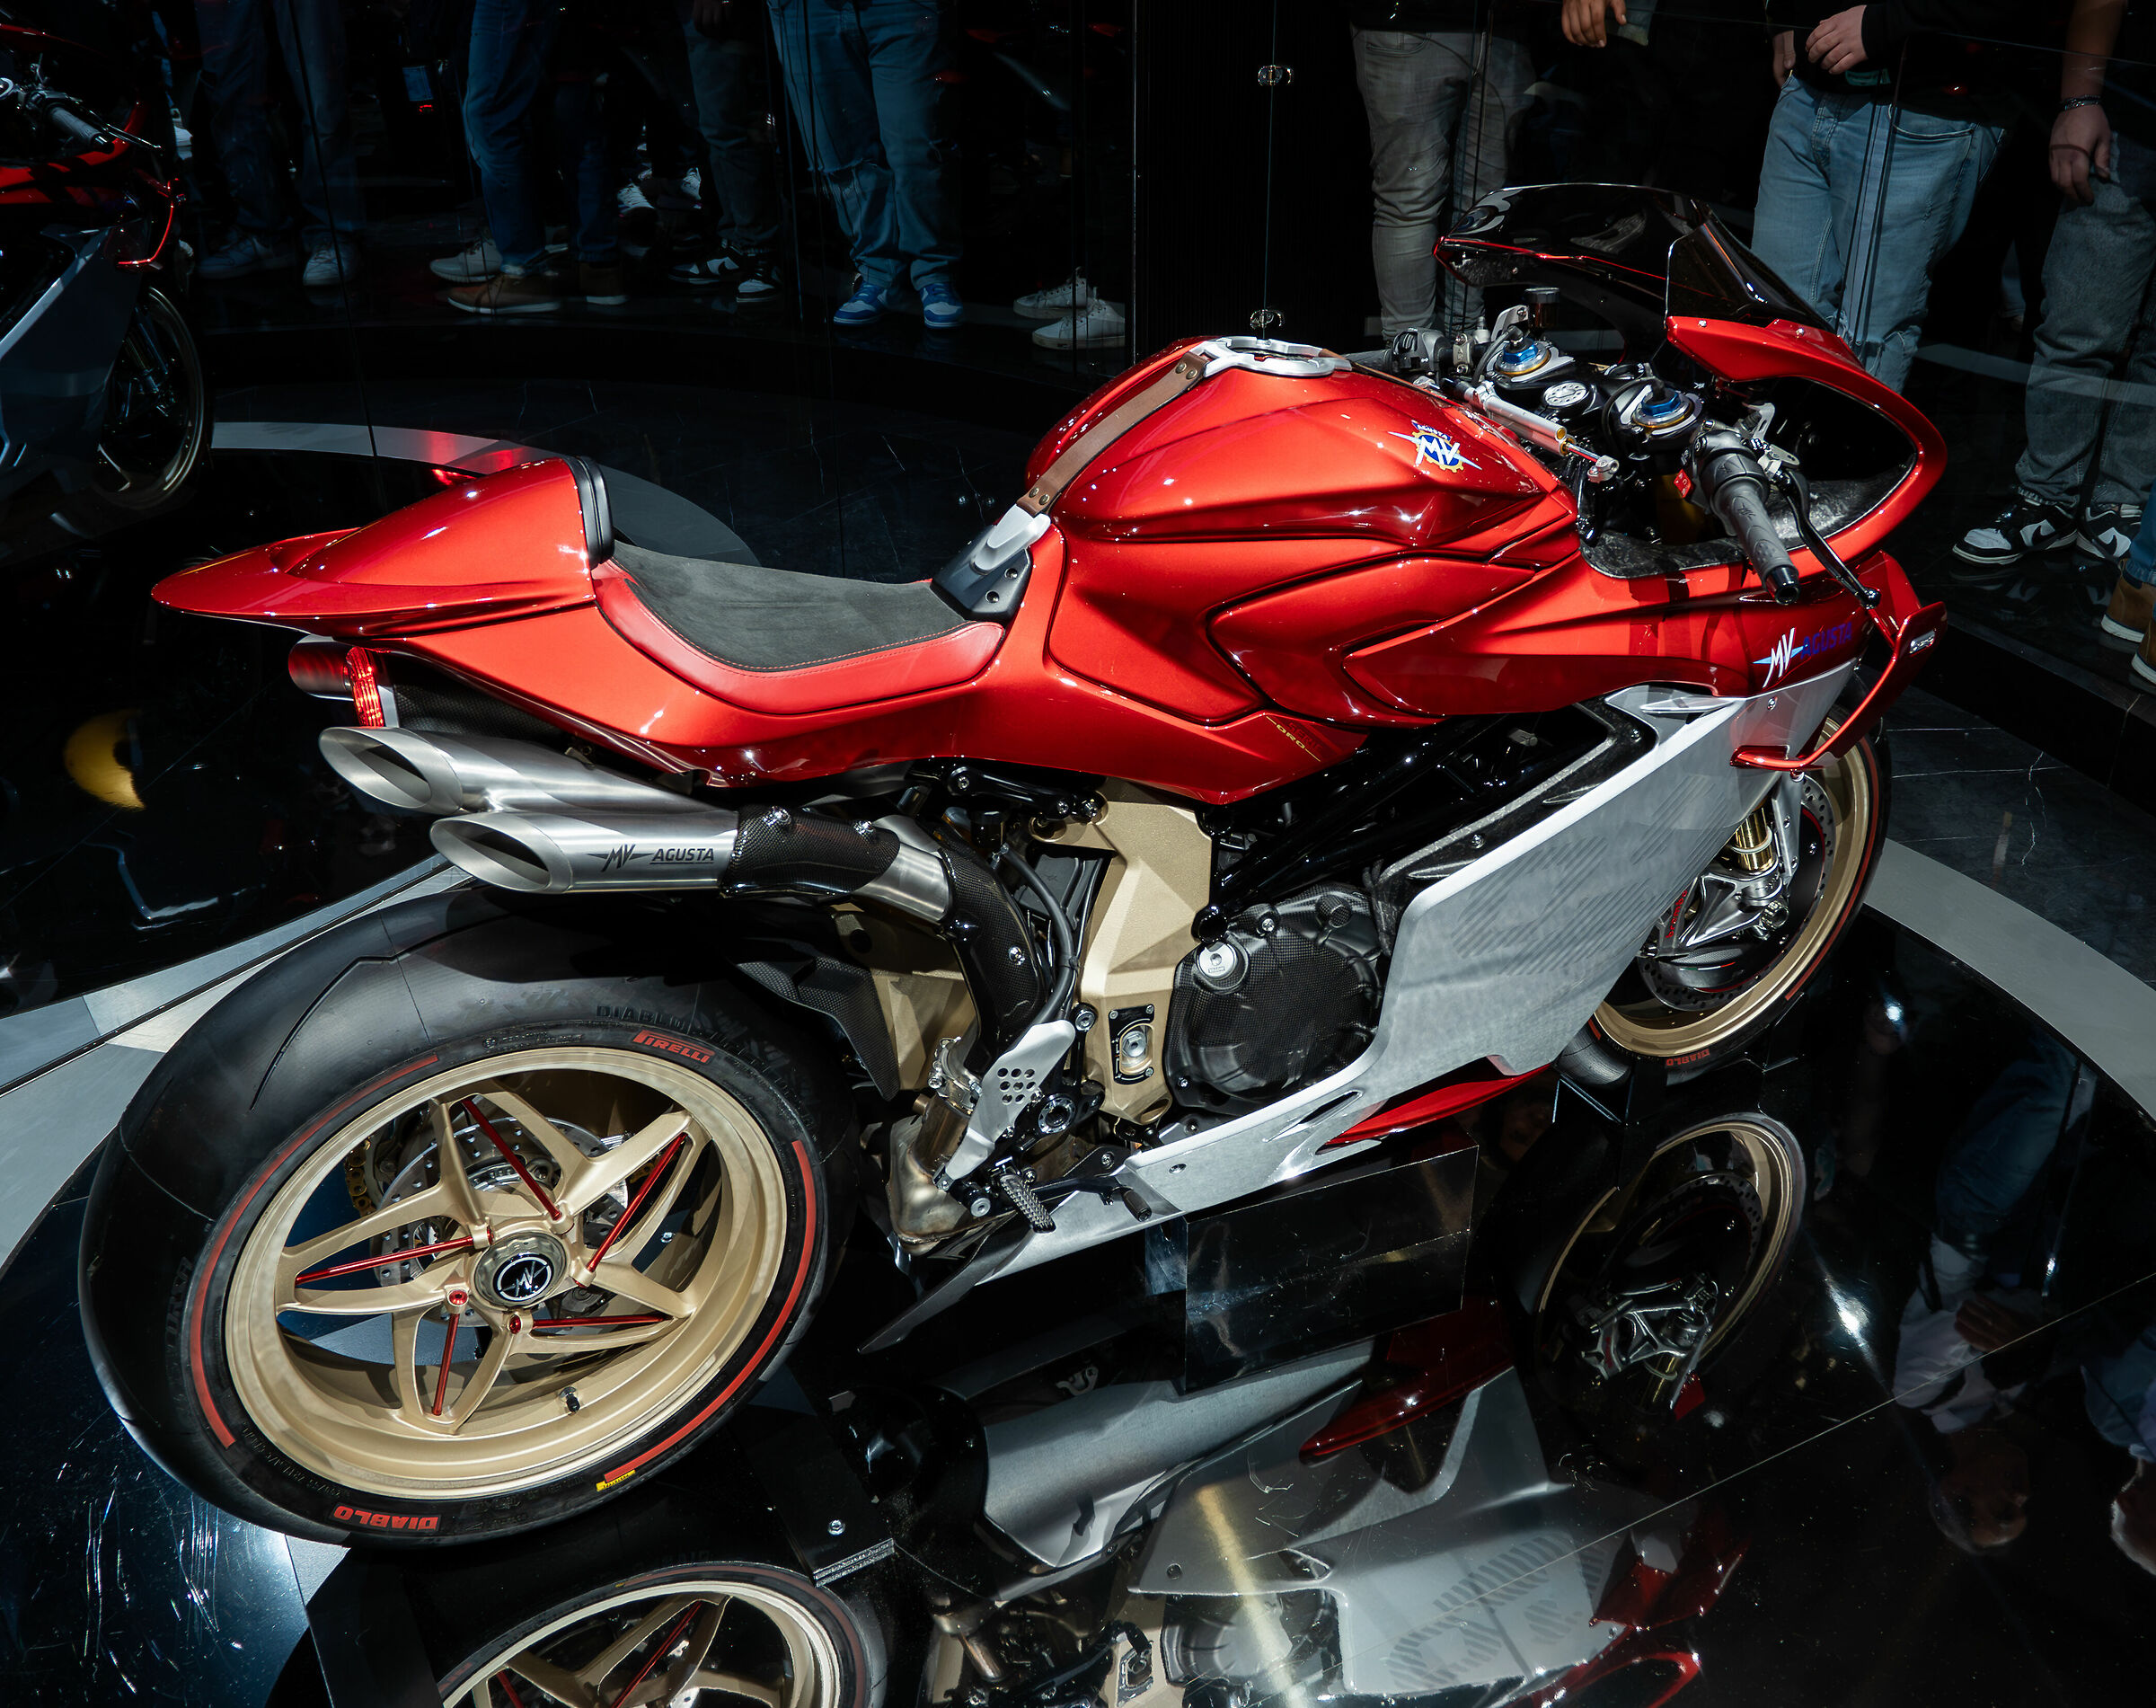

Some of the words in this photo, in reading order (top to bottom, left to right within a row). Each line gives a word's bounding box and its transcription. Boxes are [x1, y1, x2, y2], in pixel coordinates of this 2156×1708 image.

[1416, 436, 1460, 466] MV
[1763, 627, 1795, 688] MV
[1800, 622, 1852, 659] AGUSTA
[1277, 724, 1305, 748] ORO
[601, 844, 636, 872] MV
[650, 848, 714, 863] AGUSTA
[632, 1030, 716, 1064] PIRELLI
[1666, 1049, 1710, 1066] DIABLO
[333, 1505, 439, 1530] DIABLO
